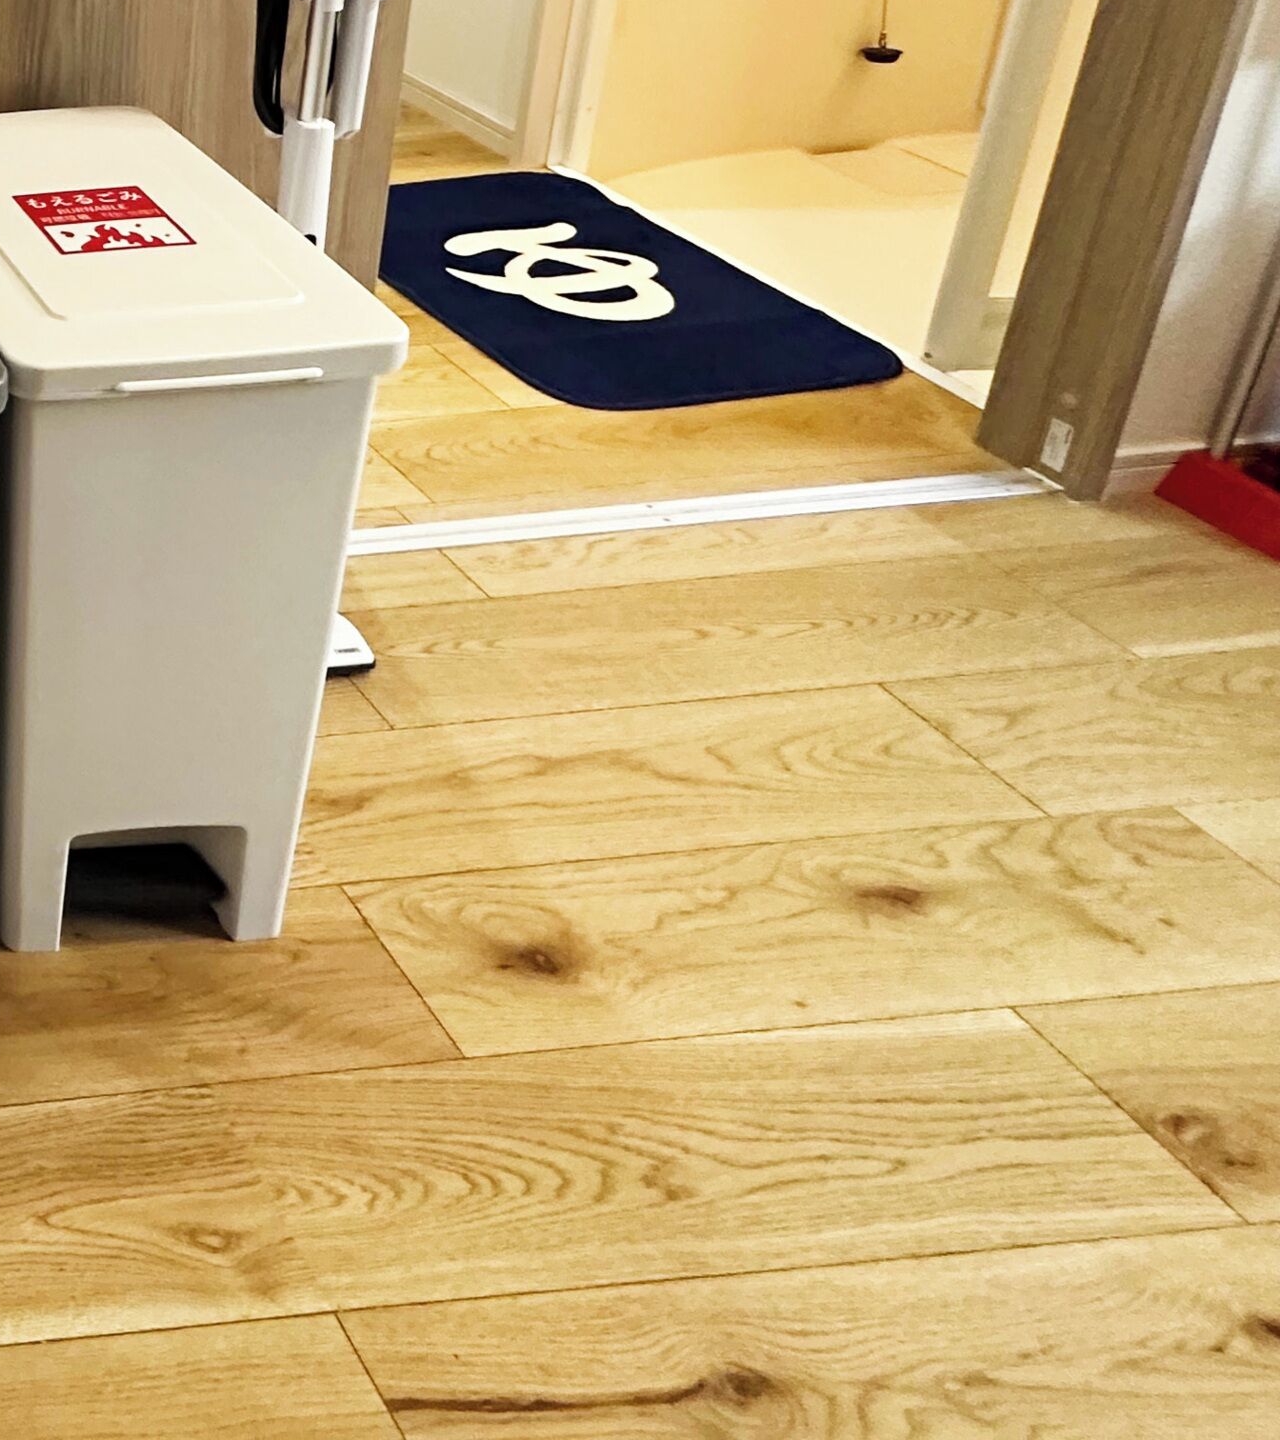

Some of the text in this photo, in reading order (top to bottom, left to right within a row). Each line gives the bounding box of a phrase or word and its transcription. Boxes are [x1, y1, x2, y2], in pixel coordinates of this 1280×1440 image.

[26, 190, 142, 209] もえるごみ
[443, 222, 676, 322] ゆ
